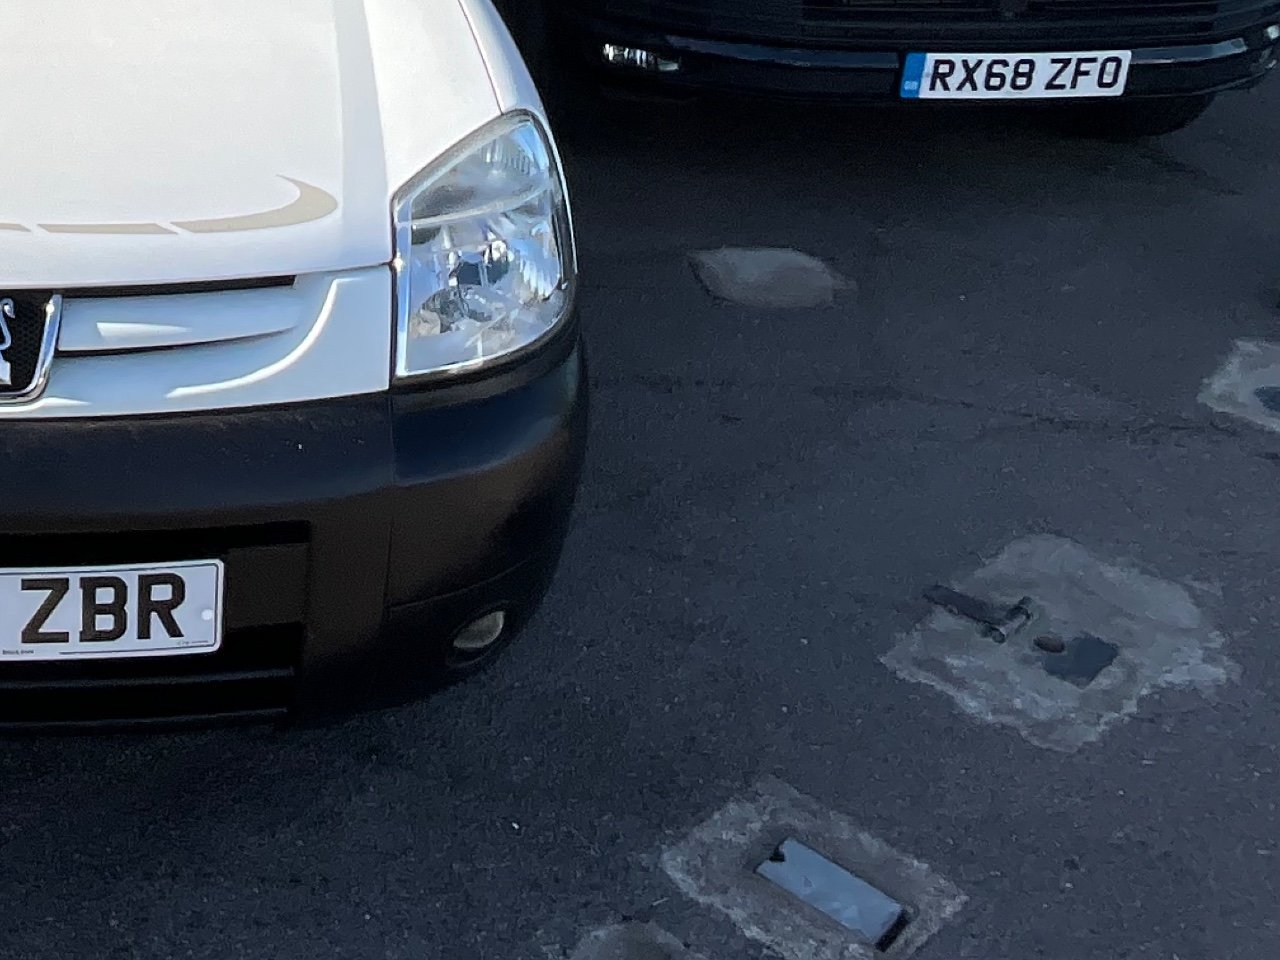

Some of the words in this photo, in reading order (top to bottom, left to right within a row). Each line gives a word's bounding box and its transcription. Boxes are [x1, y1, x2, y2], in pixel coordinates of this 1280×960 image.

[928, 58, 1036, 92] RX68
[1044, 56, 1123, 91] ZFO
[20, 572, 186, 644] ZBR
